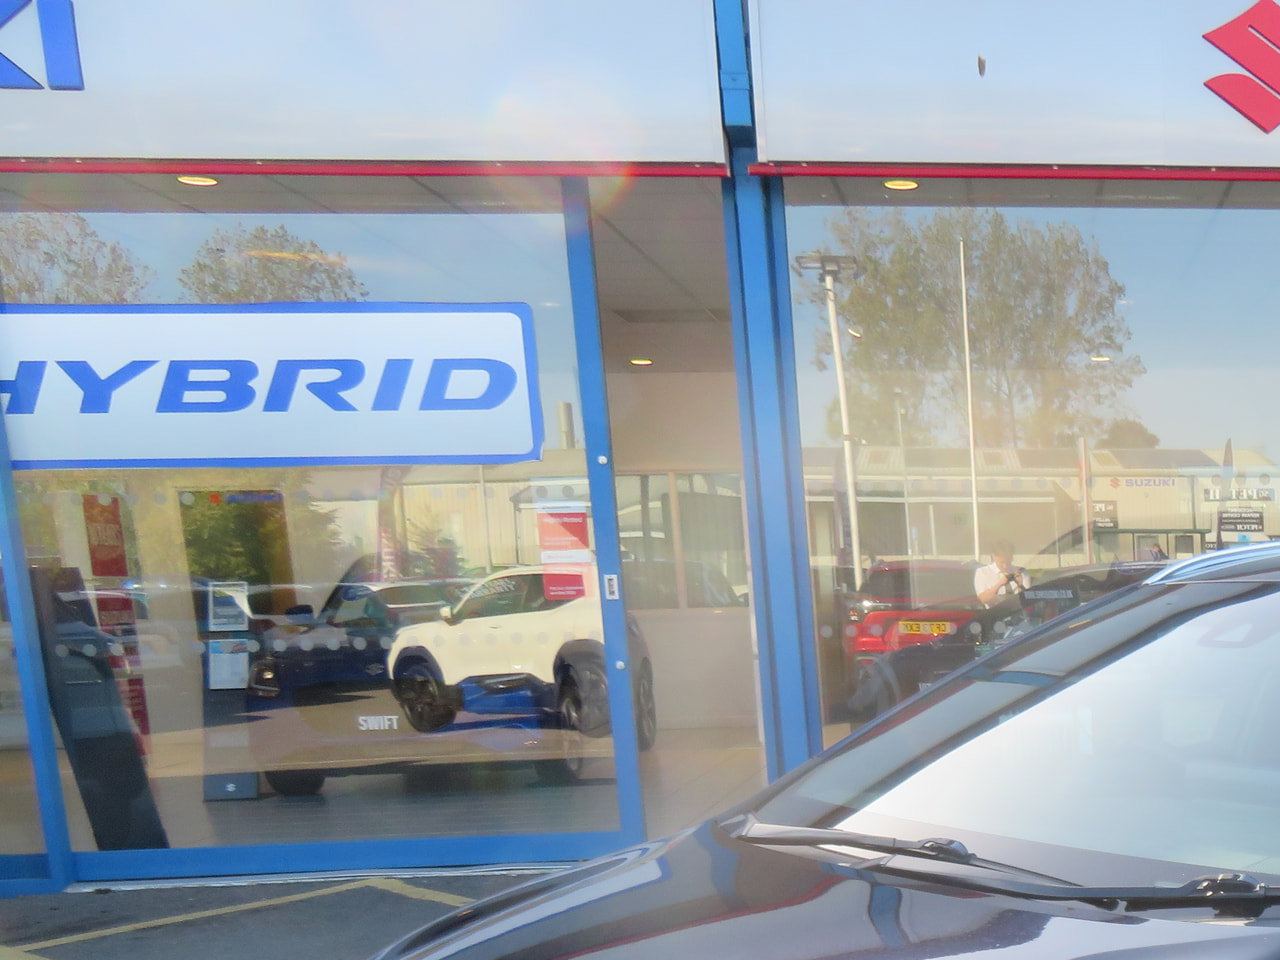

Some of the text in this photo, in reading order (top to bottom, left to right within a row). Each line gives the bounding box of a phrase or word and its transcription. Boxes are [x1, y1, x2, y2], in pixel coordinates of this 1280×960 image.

[0, 357, 518, 414] HYBRID
[1125, 477, 1175, 487] SUZUKI
[358, 715, 400, 731] SWIFT
